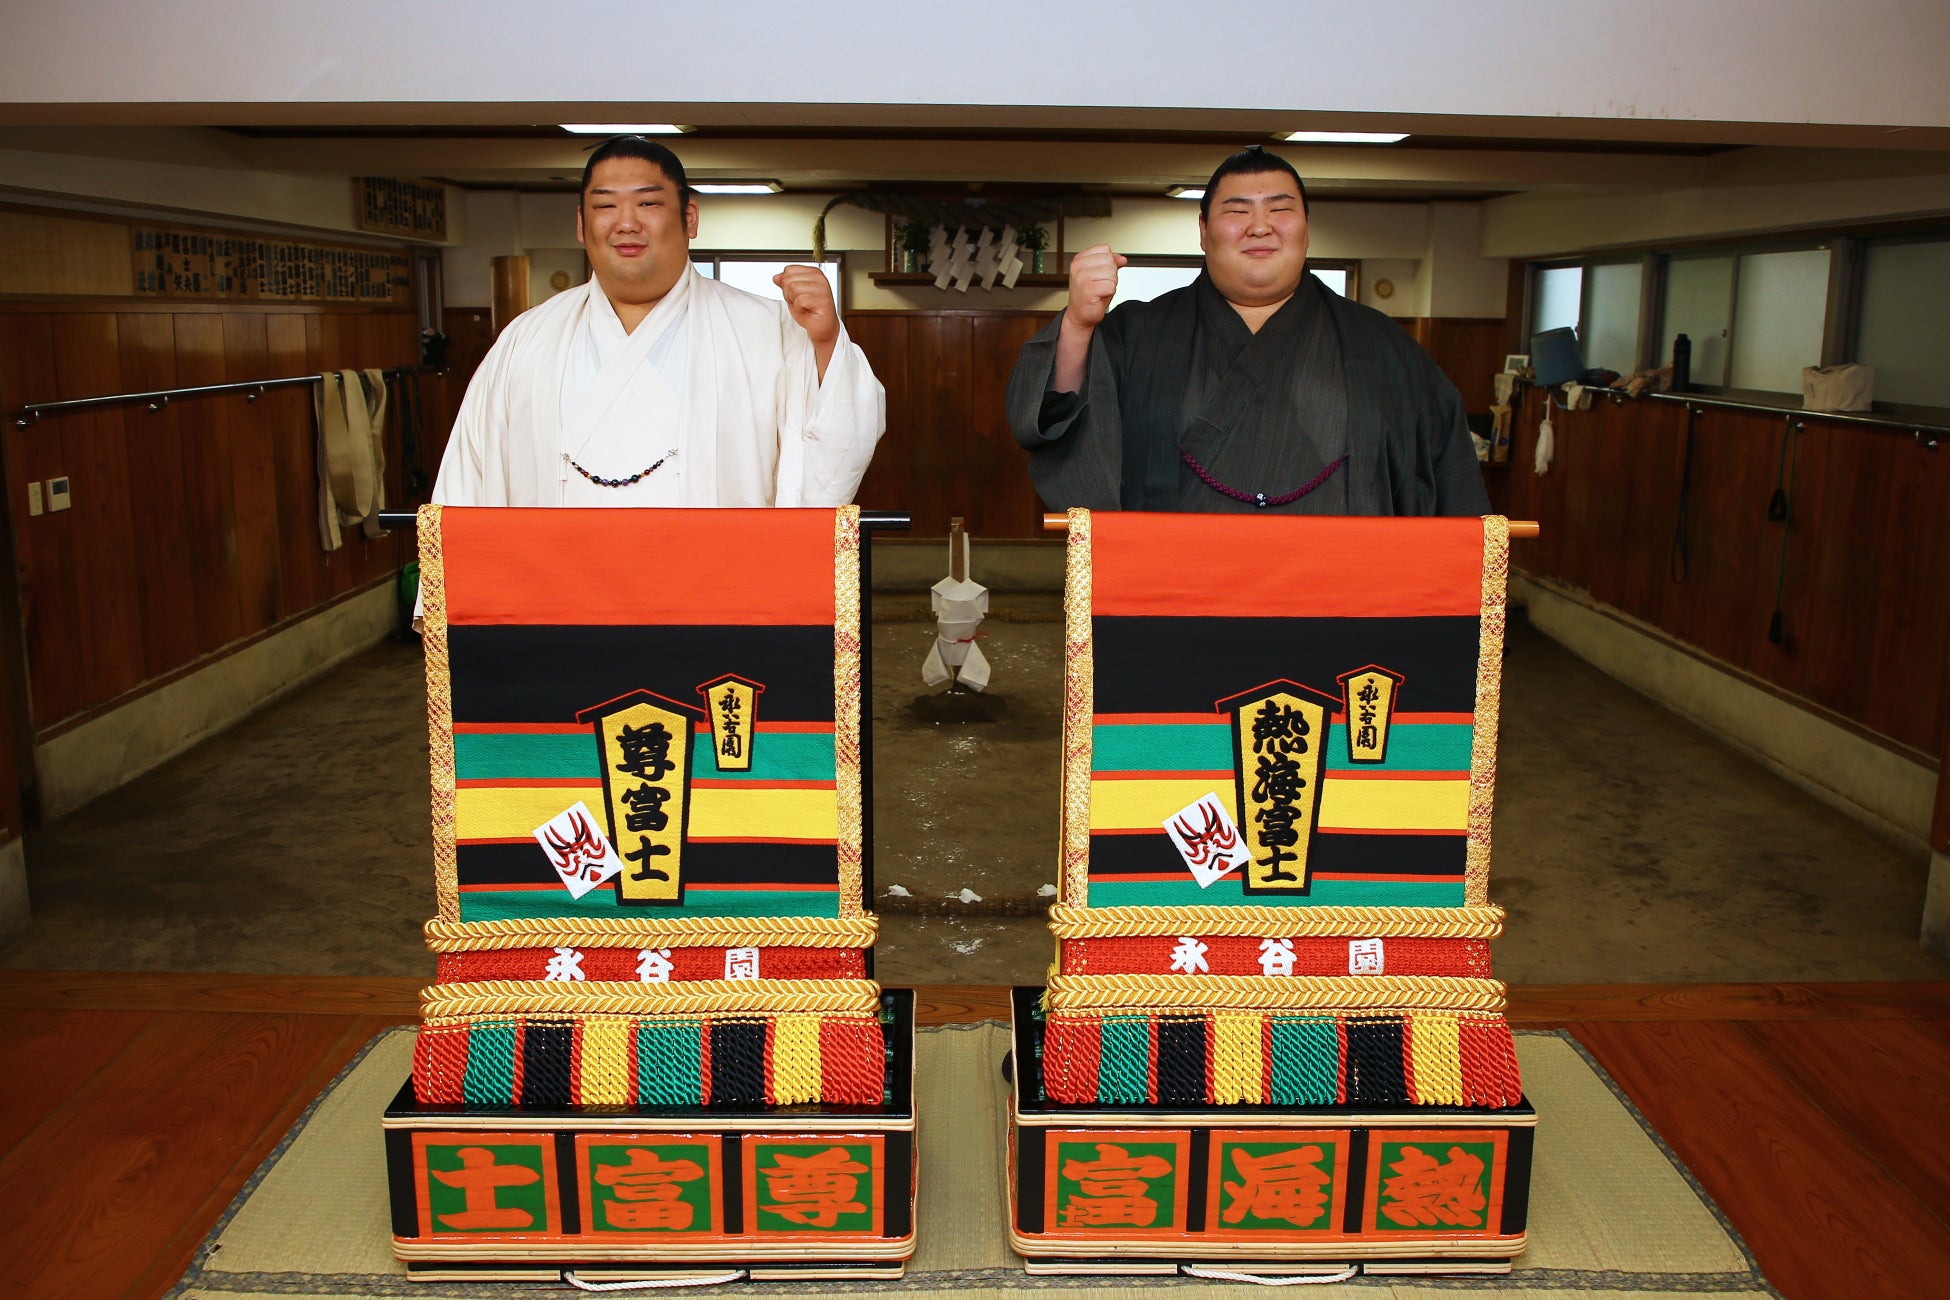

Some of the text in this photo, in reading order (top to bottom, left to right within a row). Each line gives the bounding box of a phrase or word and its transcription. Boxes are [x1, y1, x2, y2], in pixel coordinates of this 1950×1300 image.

[718, 688, 742, 758] 永谷園
[1356, 678, 1379, 750] 永谷園
[616, 722, 676, 882] 尊富士
[1251, 700, 1310, 883] 熱海富士
[545, 947, 760, 982] 永谷園
[1169, 937, 1385, 976] 永谷園
